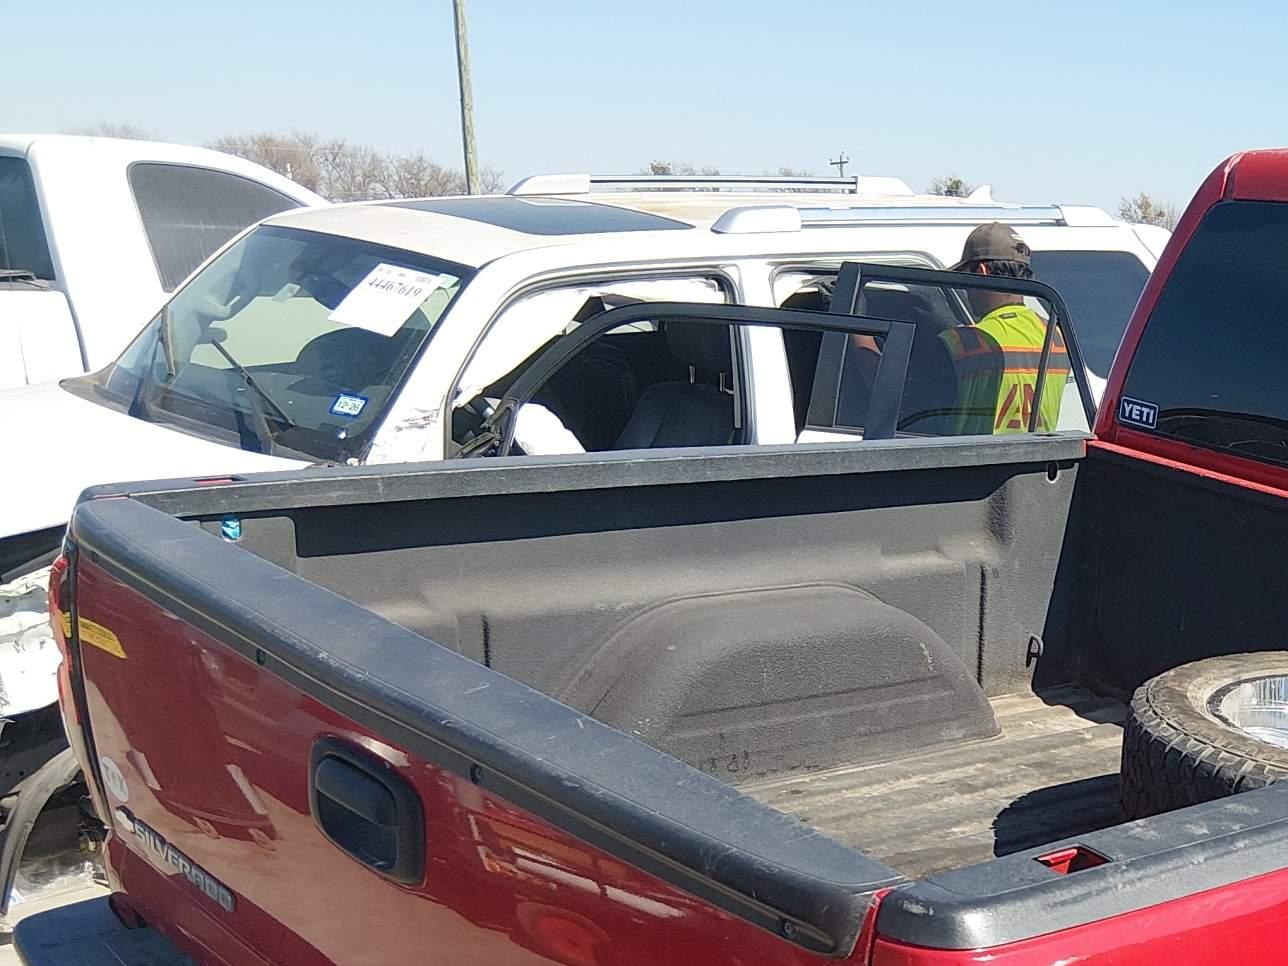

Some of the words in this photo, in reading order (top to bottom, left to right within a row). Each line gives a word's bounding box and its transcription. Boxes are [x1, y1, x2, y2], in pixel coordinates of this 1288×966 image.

[367, 277, 423, 297] 44467619
[1123, 401, 1155, 424] YETI
[133, 818, 237, 913] SILVERADO
